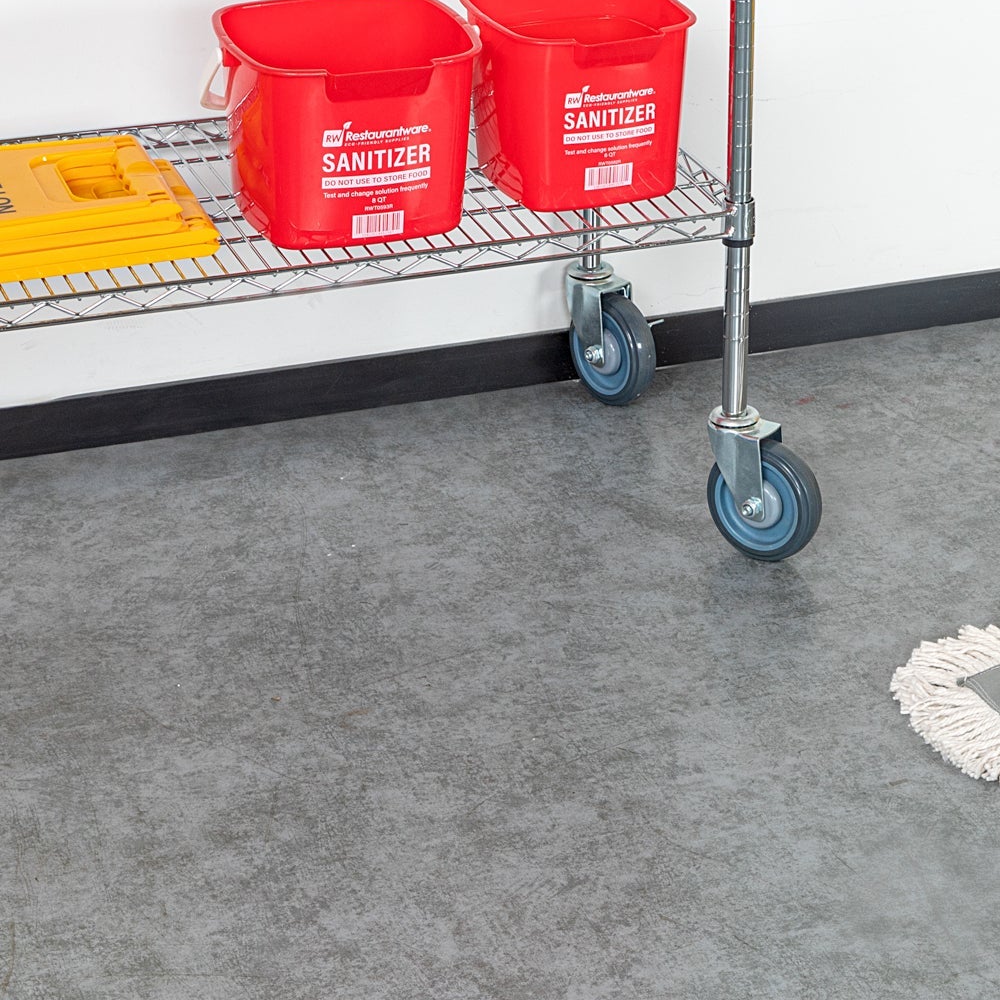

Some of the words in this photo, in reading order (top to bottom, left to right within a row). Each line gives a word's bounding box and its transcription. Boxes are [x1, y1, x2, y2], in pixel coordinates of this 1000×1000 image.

[568, 97, 581, 105] RW
[564, 103, 656, 130] SANITIZER
[326, 134, 341, 143] RW
[629, 140, 652, 149] frequently
[322, 144, 431, 173] SANITIZER
[384, 174, 406, 182] STORE
[409, 170, 428, 178] FOOD
[351, 189, 373, 197] change
[375, 187, 398, 195] solution
[400, 182, 428, 192] frequently
